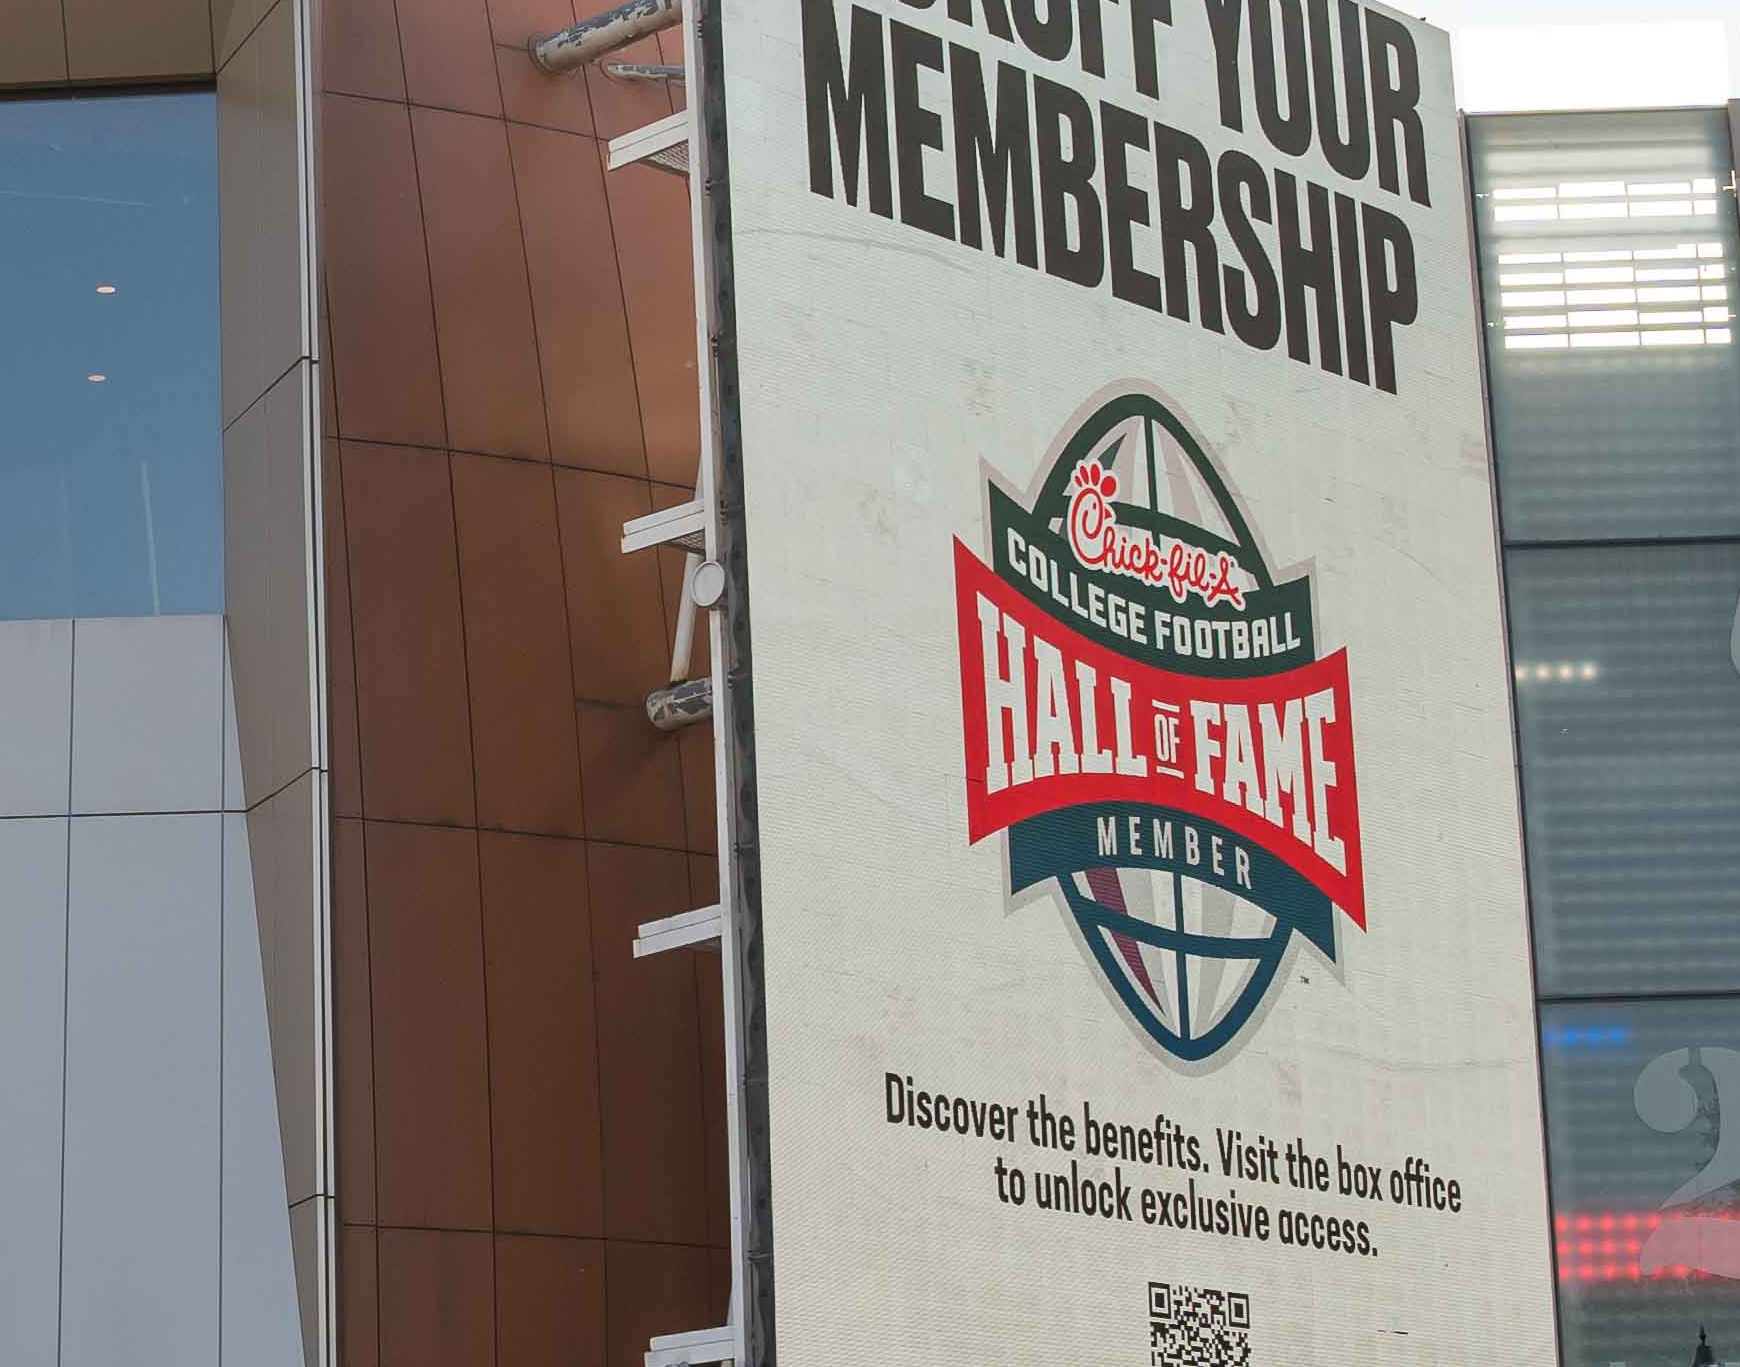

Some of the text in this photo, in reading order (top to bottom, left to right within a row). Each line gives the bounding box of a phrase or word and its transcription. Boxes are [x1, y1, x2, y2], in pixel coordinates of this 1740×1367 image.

[1007, 528, 1301, 660] COLLEGE FOOTBALL
[1071, 463, 1242, 605] Chick-fil-A
[977, 591, 1347, 878] HALL OF FAME
[1097, 816, 1253, 890] MEMBER
[885, 1072, 1462, 1213] Discover the benefits. Visit the box office
[995, 1157, 1379, 1257] to unlock exclusive access.
